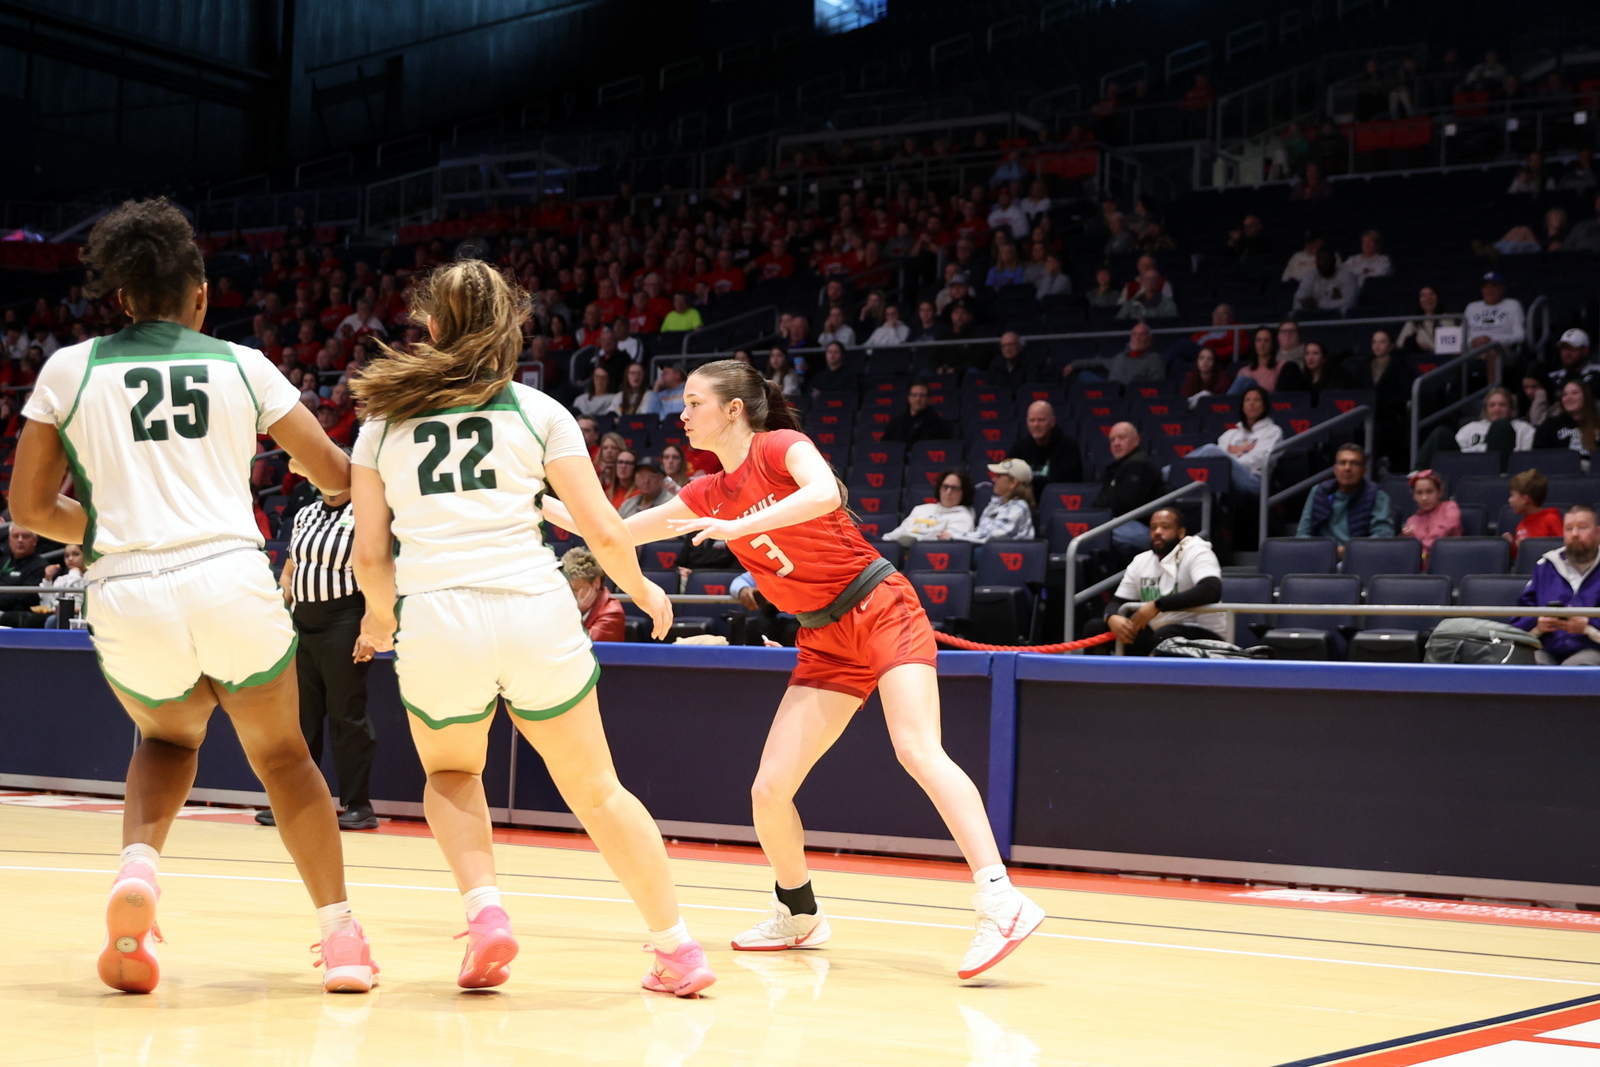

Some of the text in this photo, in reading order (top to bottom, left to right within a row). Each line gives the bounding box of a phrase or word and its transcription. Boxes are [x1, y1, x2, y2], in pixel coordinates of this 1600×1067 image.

[124, 365, 209, 442] 25
[414, 417, 497, 496] 22
[749, 533, 795, 577] 3
